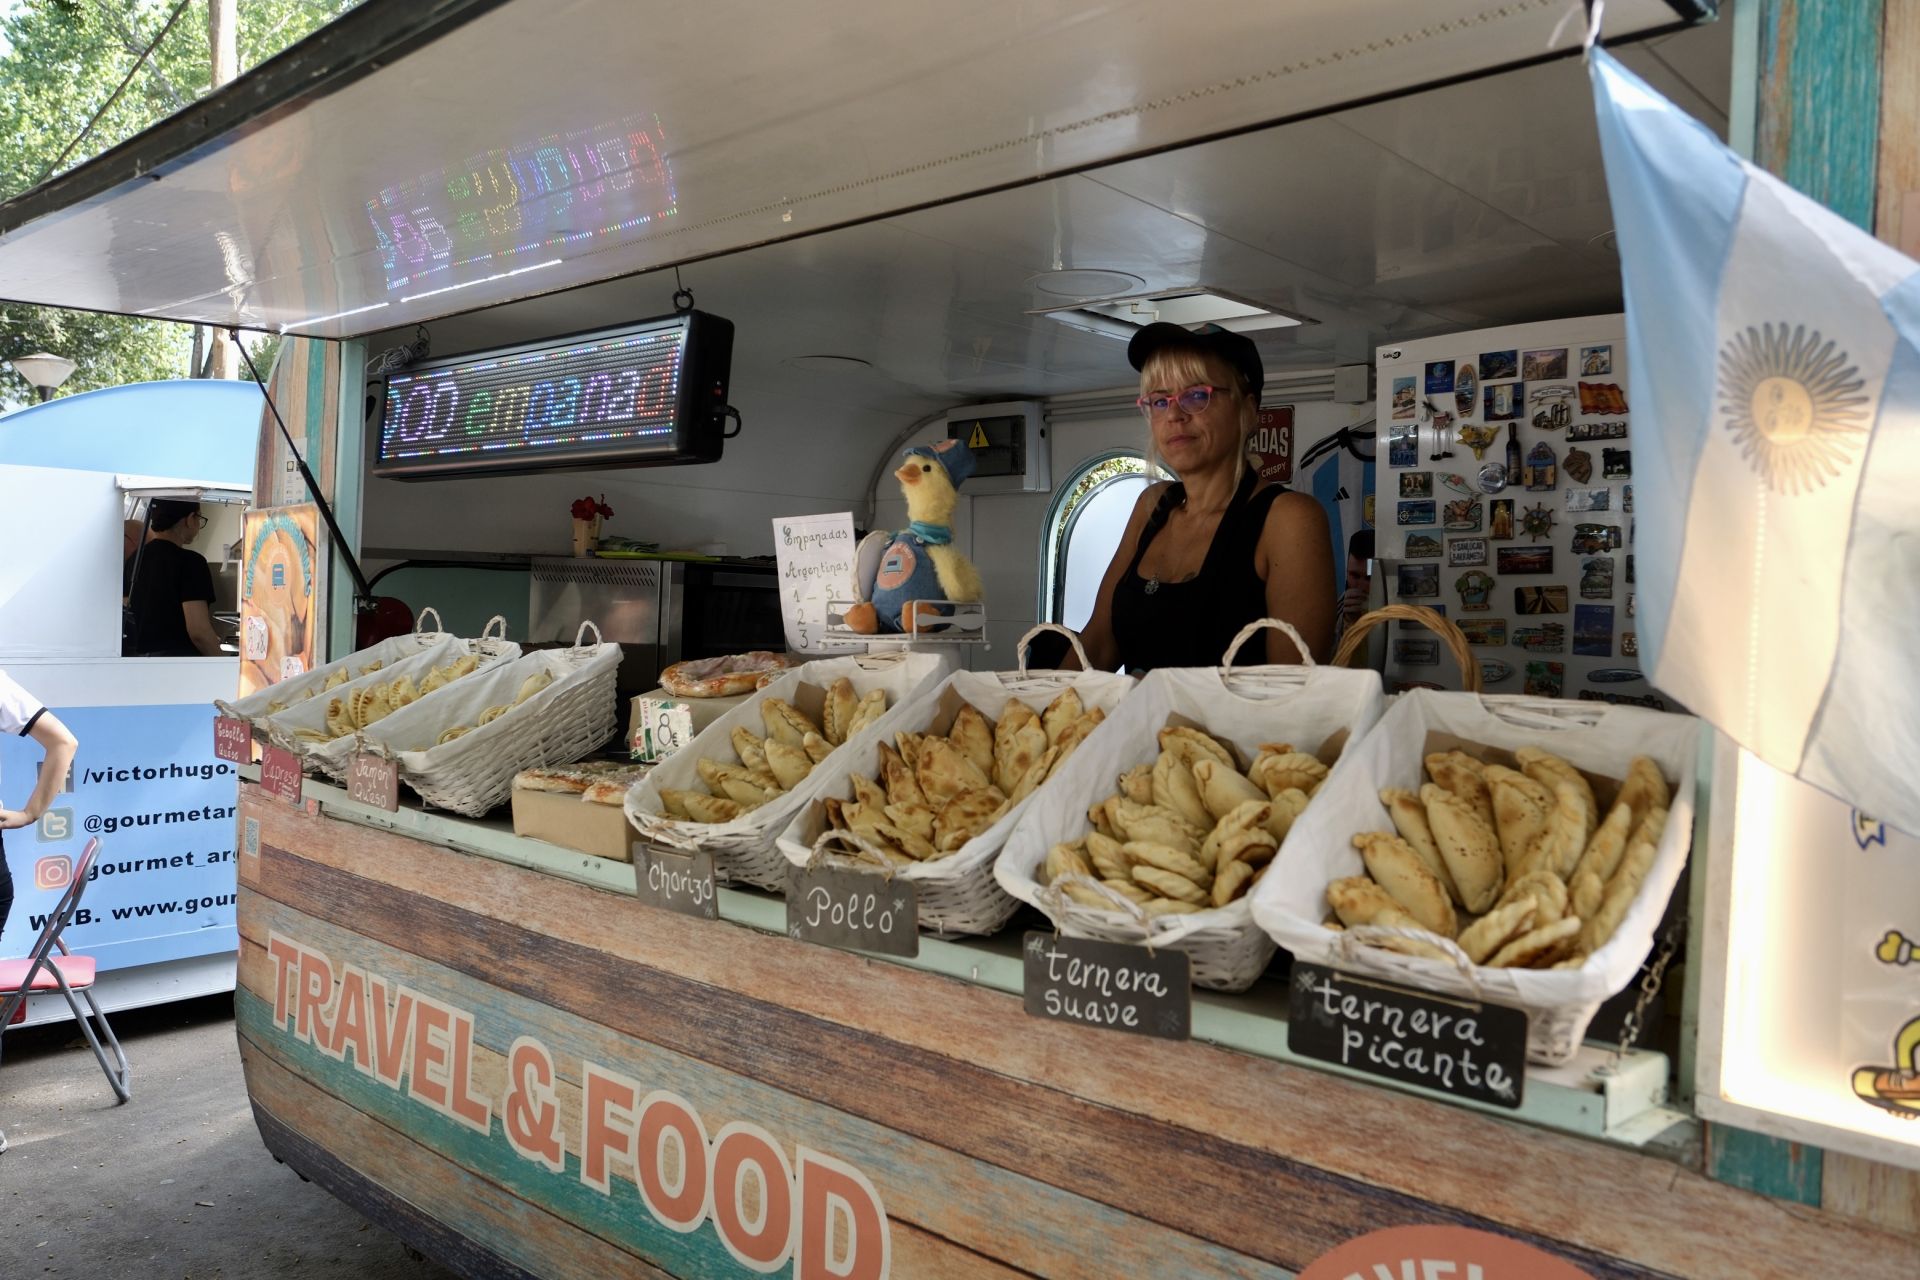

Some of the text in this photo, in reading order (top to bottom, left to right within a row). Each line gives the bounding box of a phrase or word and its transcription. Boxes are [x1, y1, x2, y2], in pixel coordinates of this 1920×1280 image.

[1249, 427, 1289, 458] ADAS
[1261, 462, 1287, 478] CRISPY
[783, 525, 848, 551] Empanadas
[785, 560, 849, 581] Argentinas
[798, 629, 809, 649] 3
[83, 762, 236, 785] /victorhugo.
[263, 753, 299, 790] Caprese
[355, 782, 387, 808] Queso
[84, 804, 236, 834] @gourmetar
[88, 850, 236, 881] gourmet_ar
[649, 863, 713, 905] Chorizo
[806, 886, 893, 934] Pollo
[1045, 949, 1168, 998] ternera
[1044, 988, 1139, 1027] suave
[1314, 979, 1485, 1046] ternera
[1342, 1023, 1508, 1092] picante
[268, 932, 892, 1280] TRAVEL & FOOD
